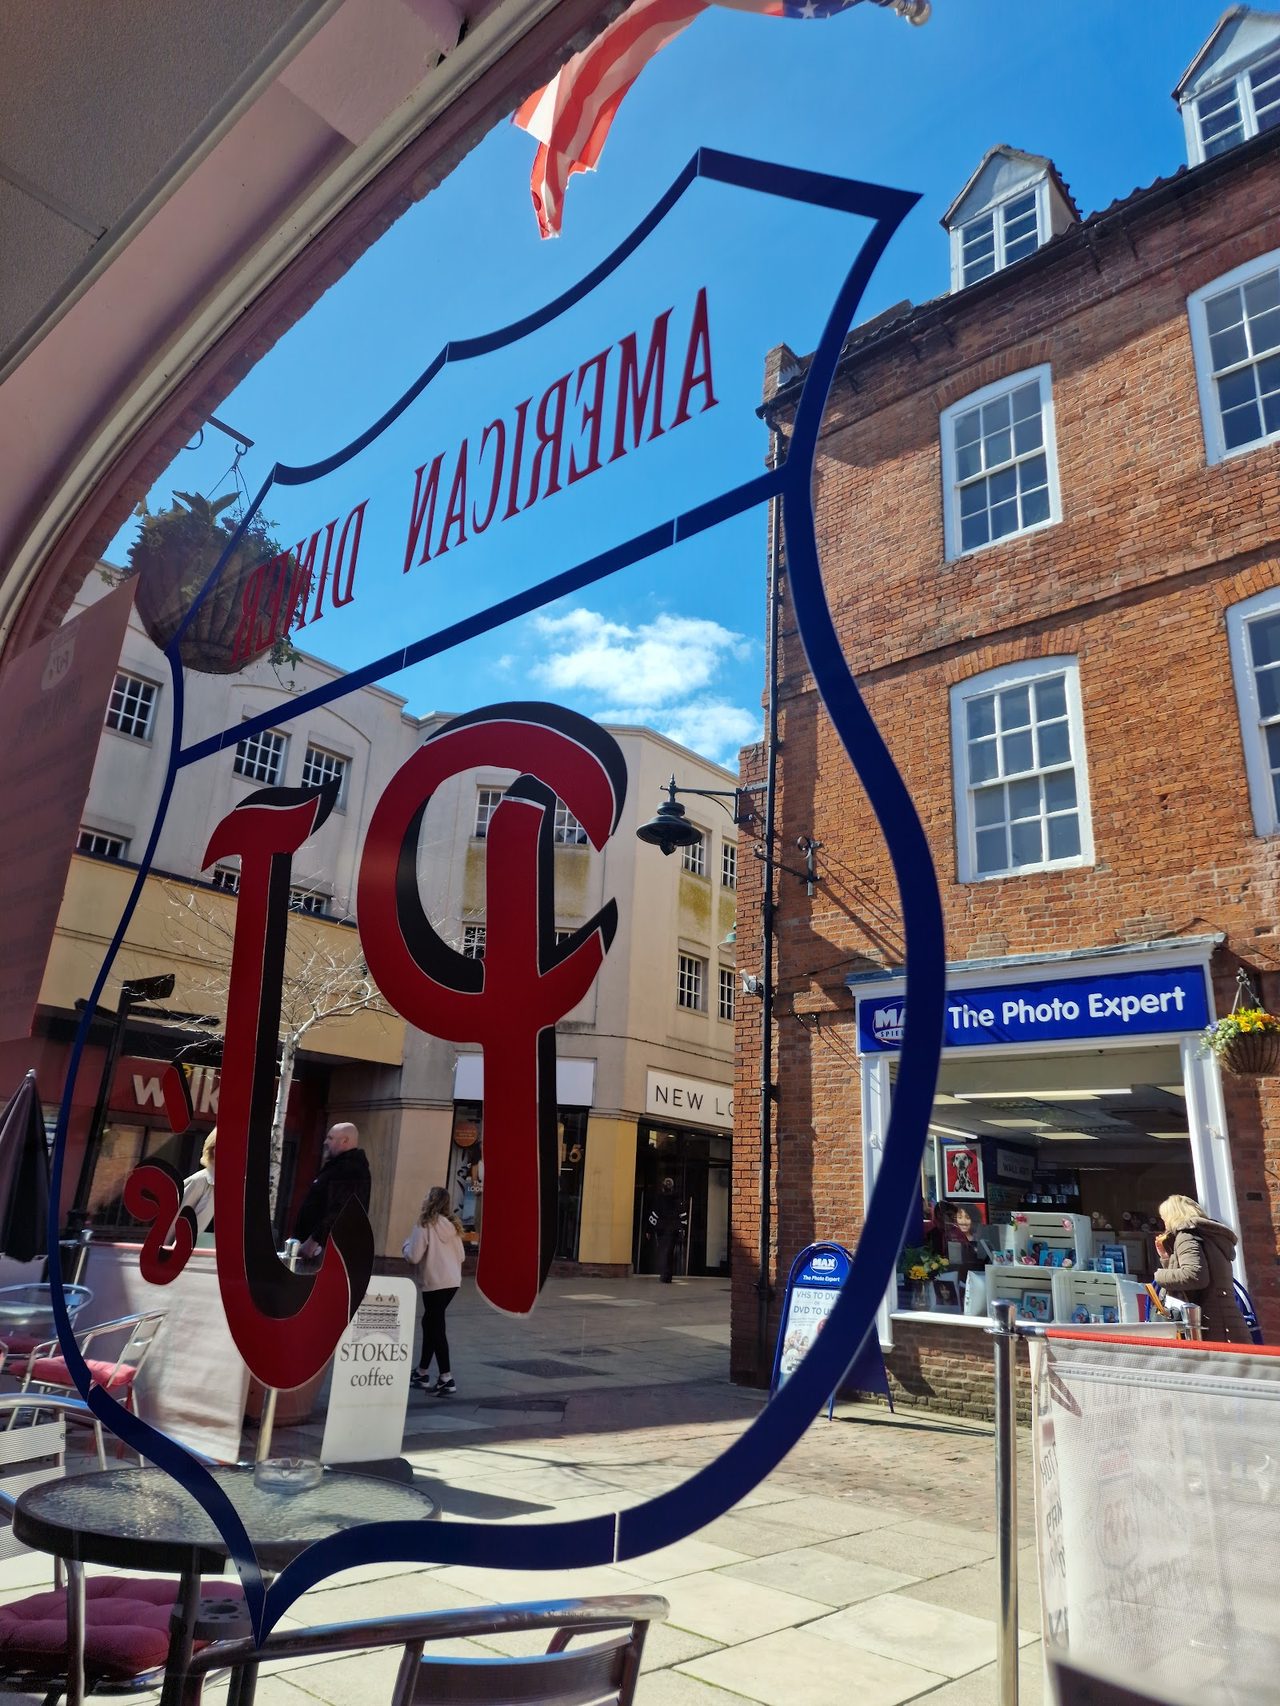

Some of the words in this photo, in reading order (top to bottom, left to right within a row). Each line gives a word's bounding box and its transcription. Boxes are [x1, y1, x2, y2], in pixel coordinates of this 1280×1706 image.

[948, 1004, 995, 1030] The
[1002, 998, 1079, 1025] Photo
[1088, 986, 1186, 1022] Expert
[655, 1085, 704, 1110] NEW
[812, 1258, 835, 1267] MAX
[796, 1290, 812, 1299] VHS
[811, 1307, 823, 1315] TO
[339, 1343, 408, 1362] STOKES
[350, 1367, 393, 1387] coffee
